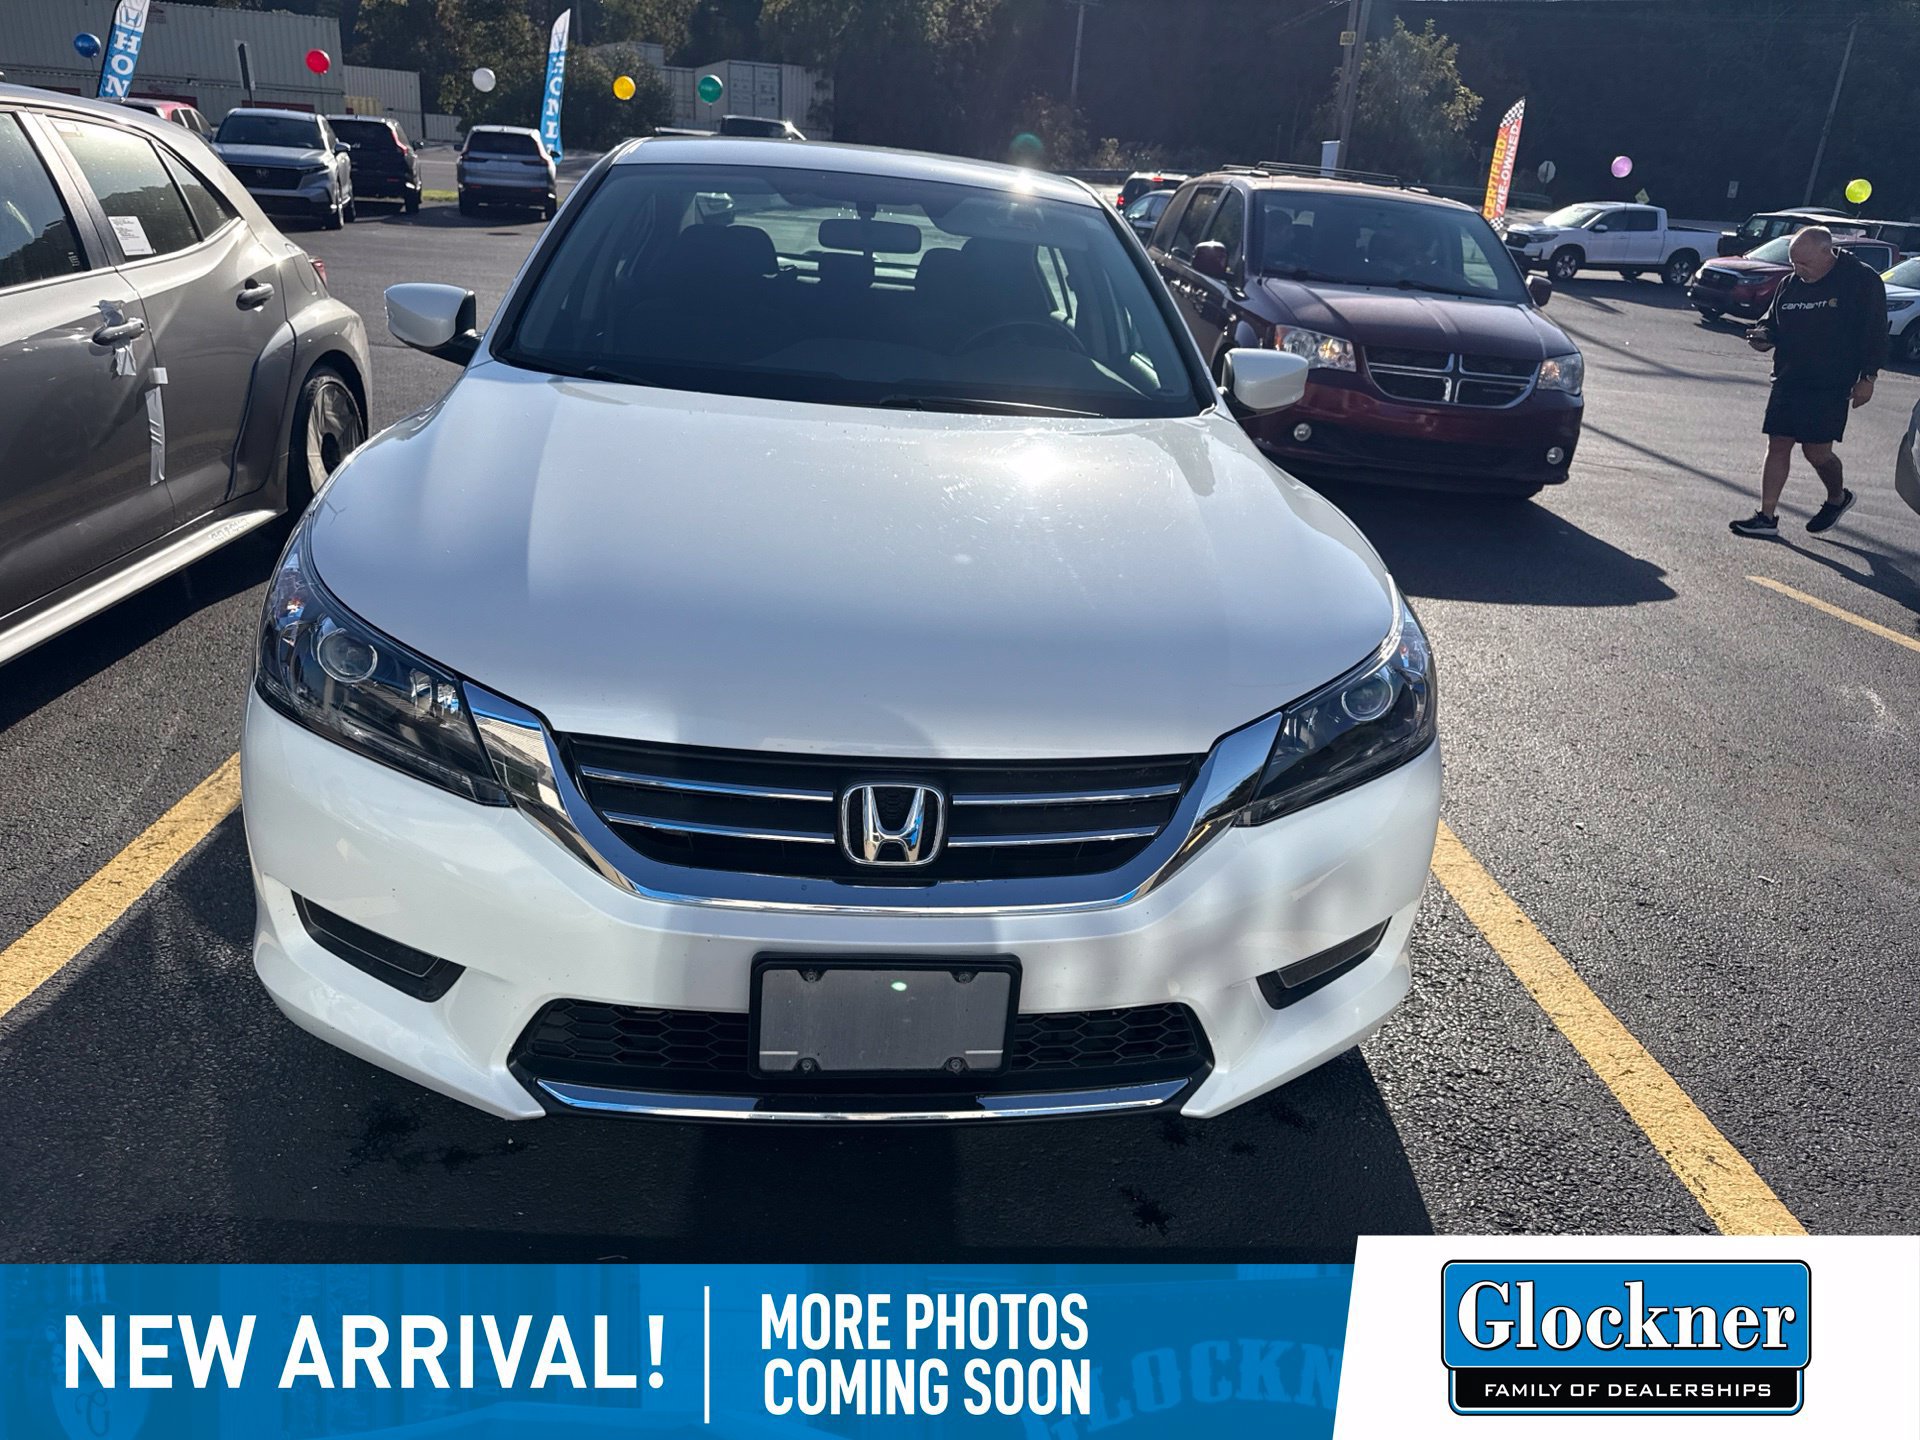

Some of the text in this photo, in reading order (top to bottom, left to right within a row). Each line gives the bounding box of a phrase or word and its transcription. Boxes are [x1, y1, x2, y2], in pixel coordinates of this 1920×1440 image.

[1483, 136, 1508, 219] CERTIFIED
[1495, 123, 1519, 215] PRE-OWNED
[1781, 300, 1827, 310] carhartt
